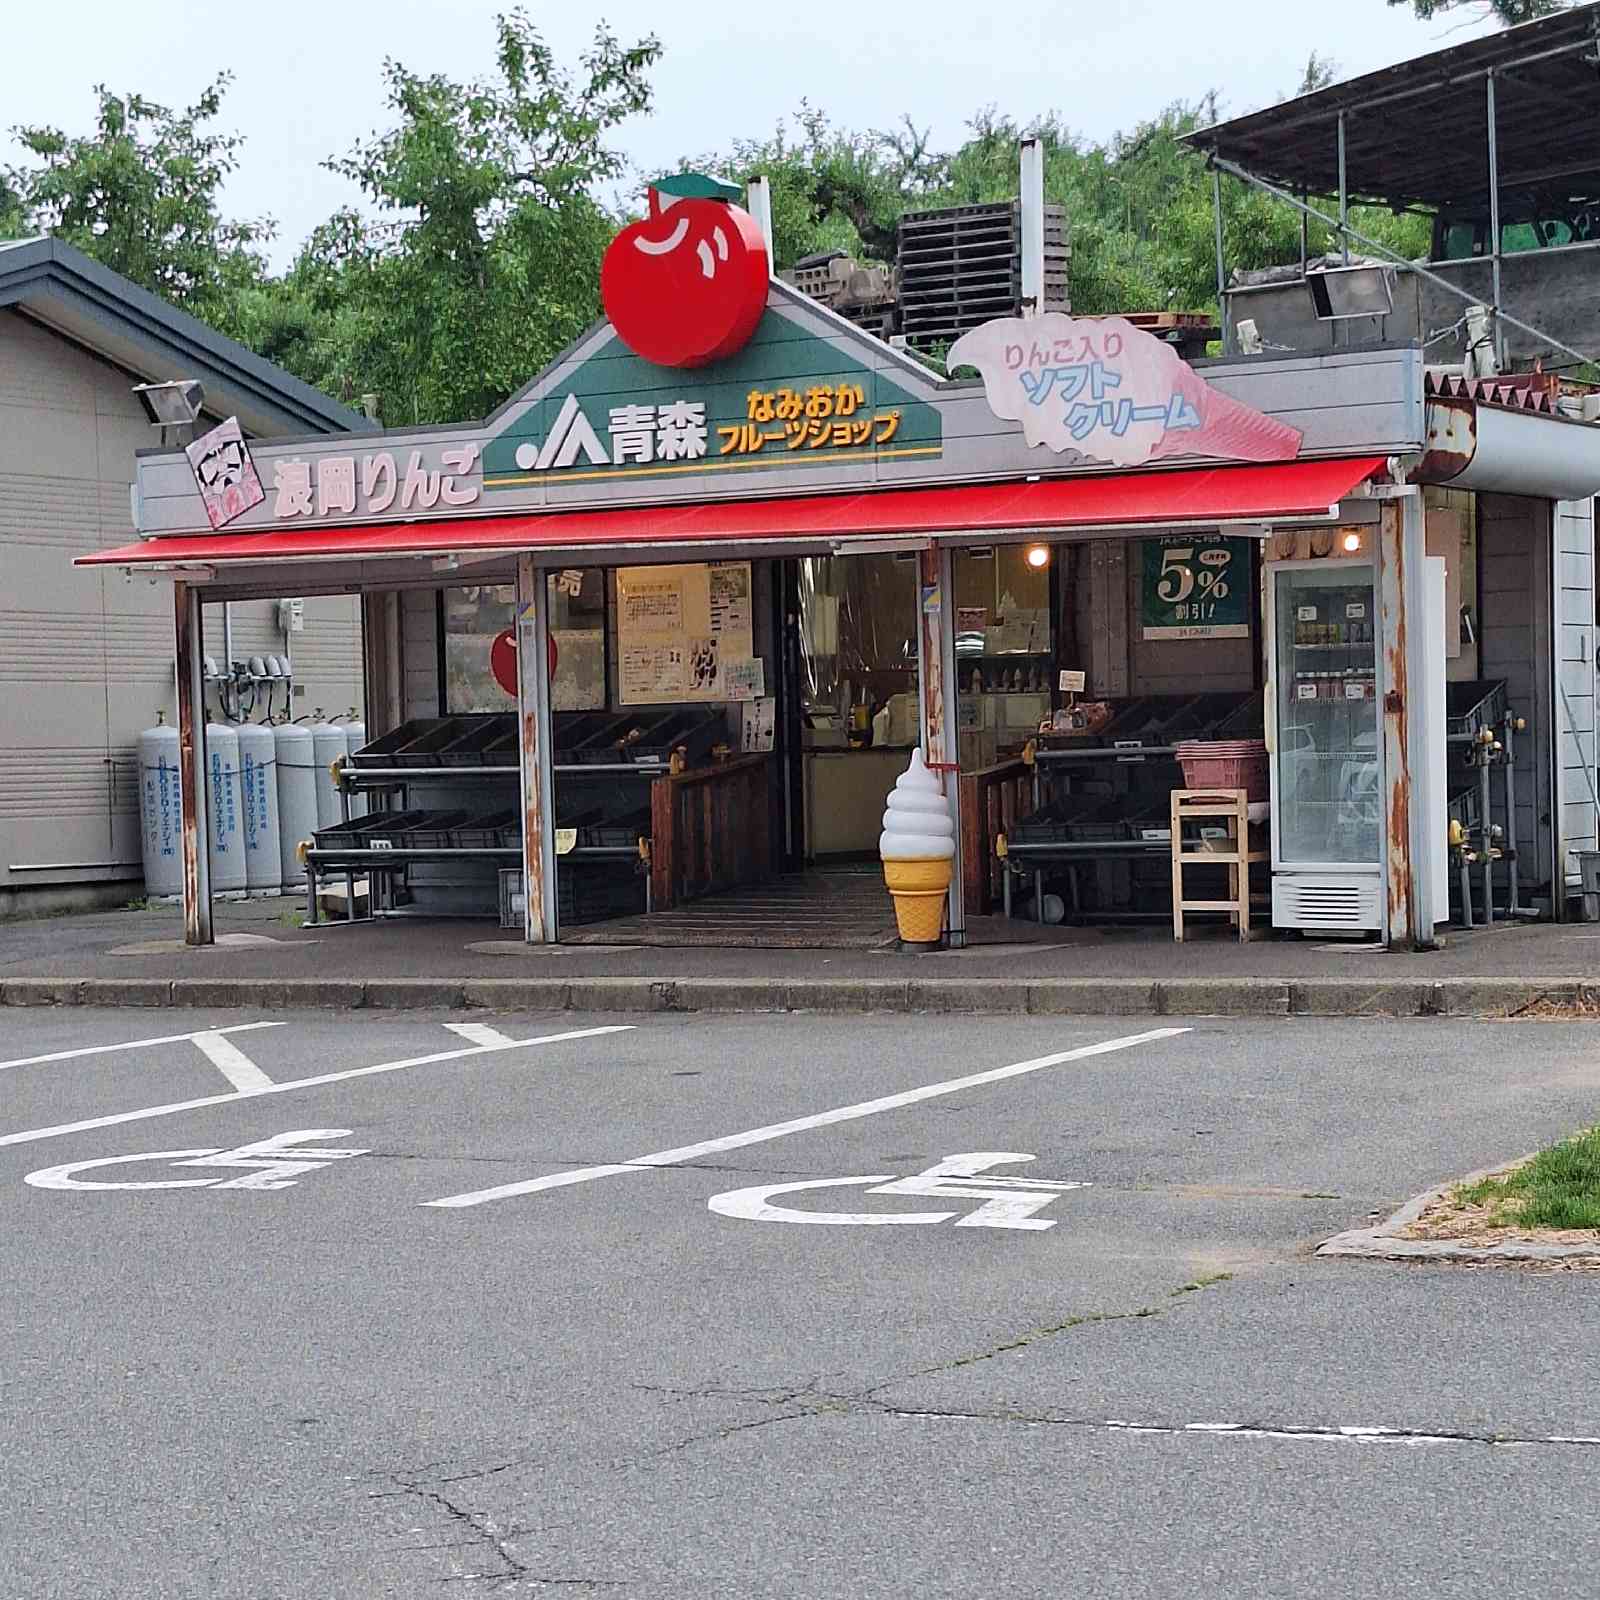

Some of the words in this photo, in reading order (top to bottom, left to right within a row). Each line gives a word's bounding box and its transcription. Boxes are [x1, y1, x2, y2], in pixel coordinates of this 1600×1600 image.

[747, 383, 866, 423] なみおか
[1019, 361, 1122, 406] ソフト
[717, 409, 901, 455] フルーツショップ
[1062, 393, 1201, 441] クリーム
[273, 442, 480, 518] 浪岡りんご
